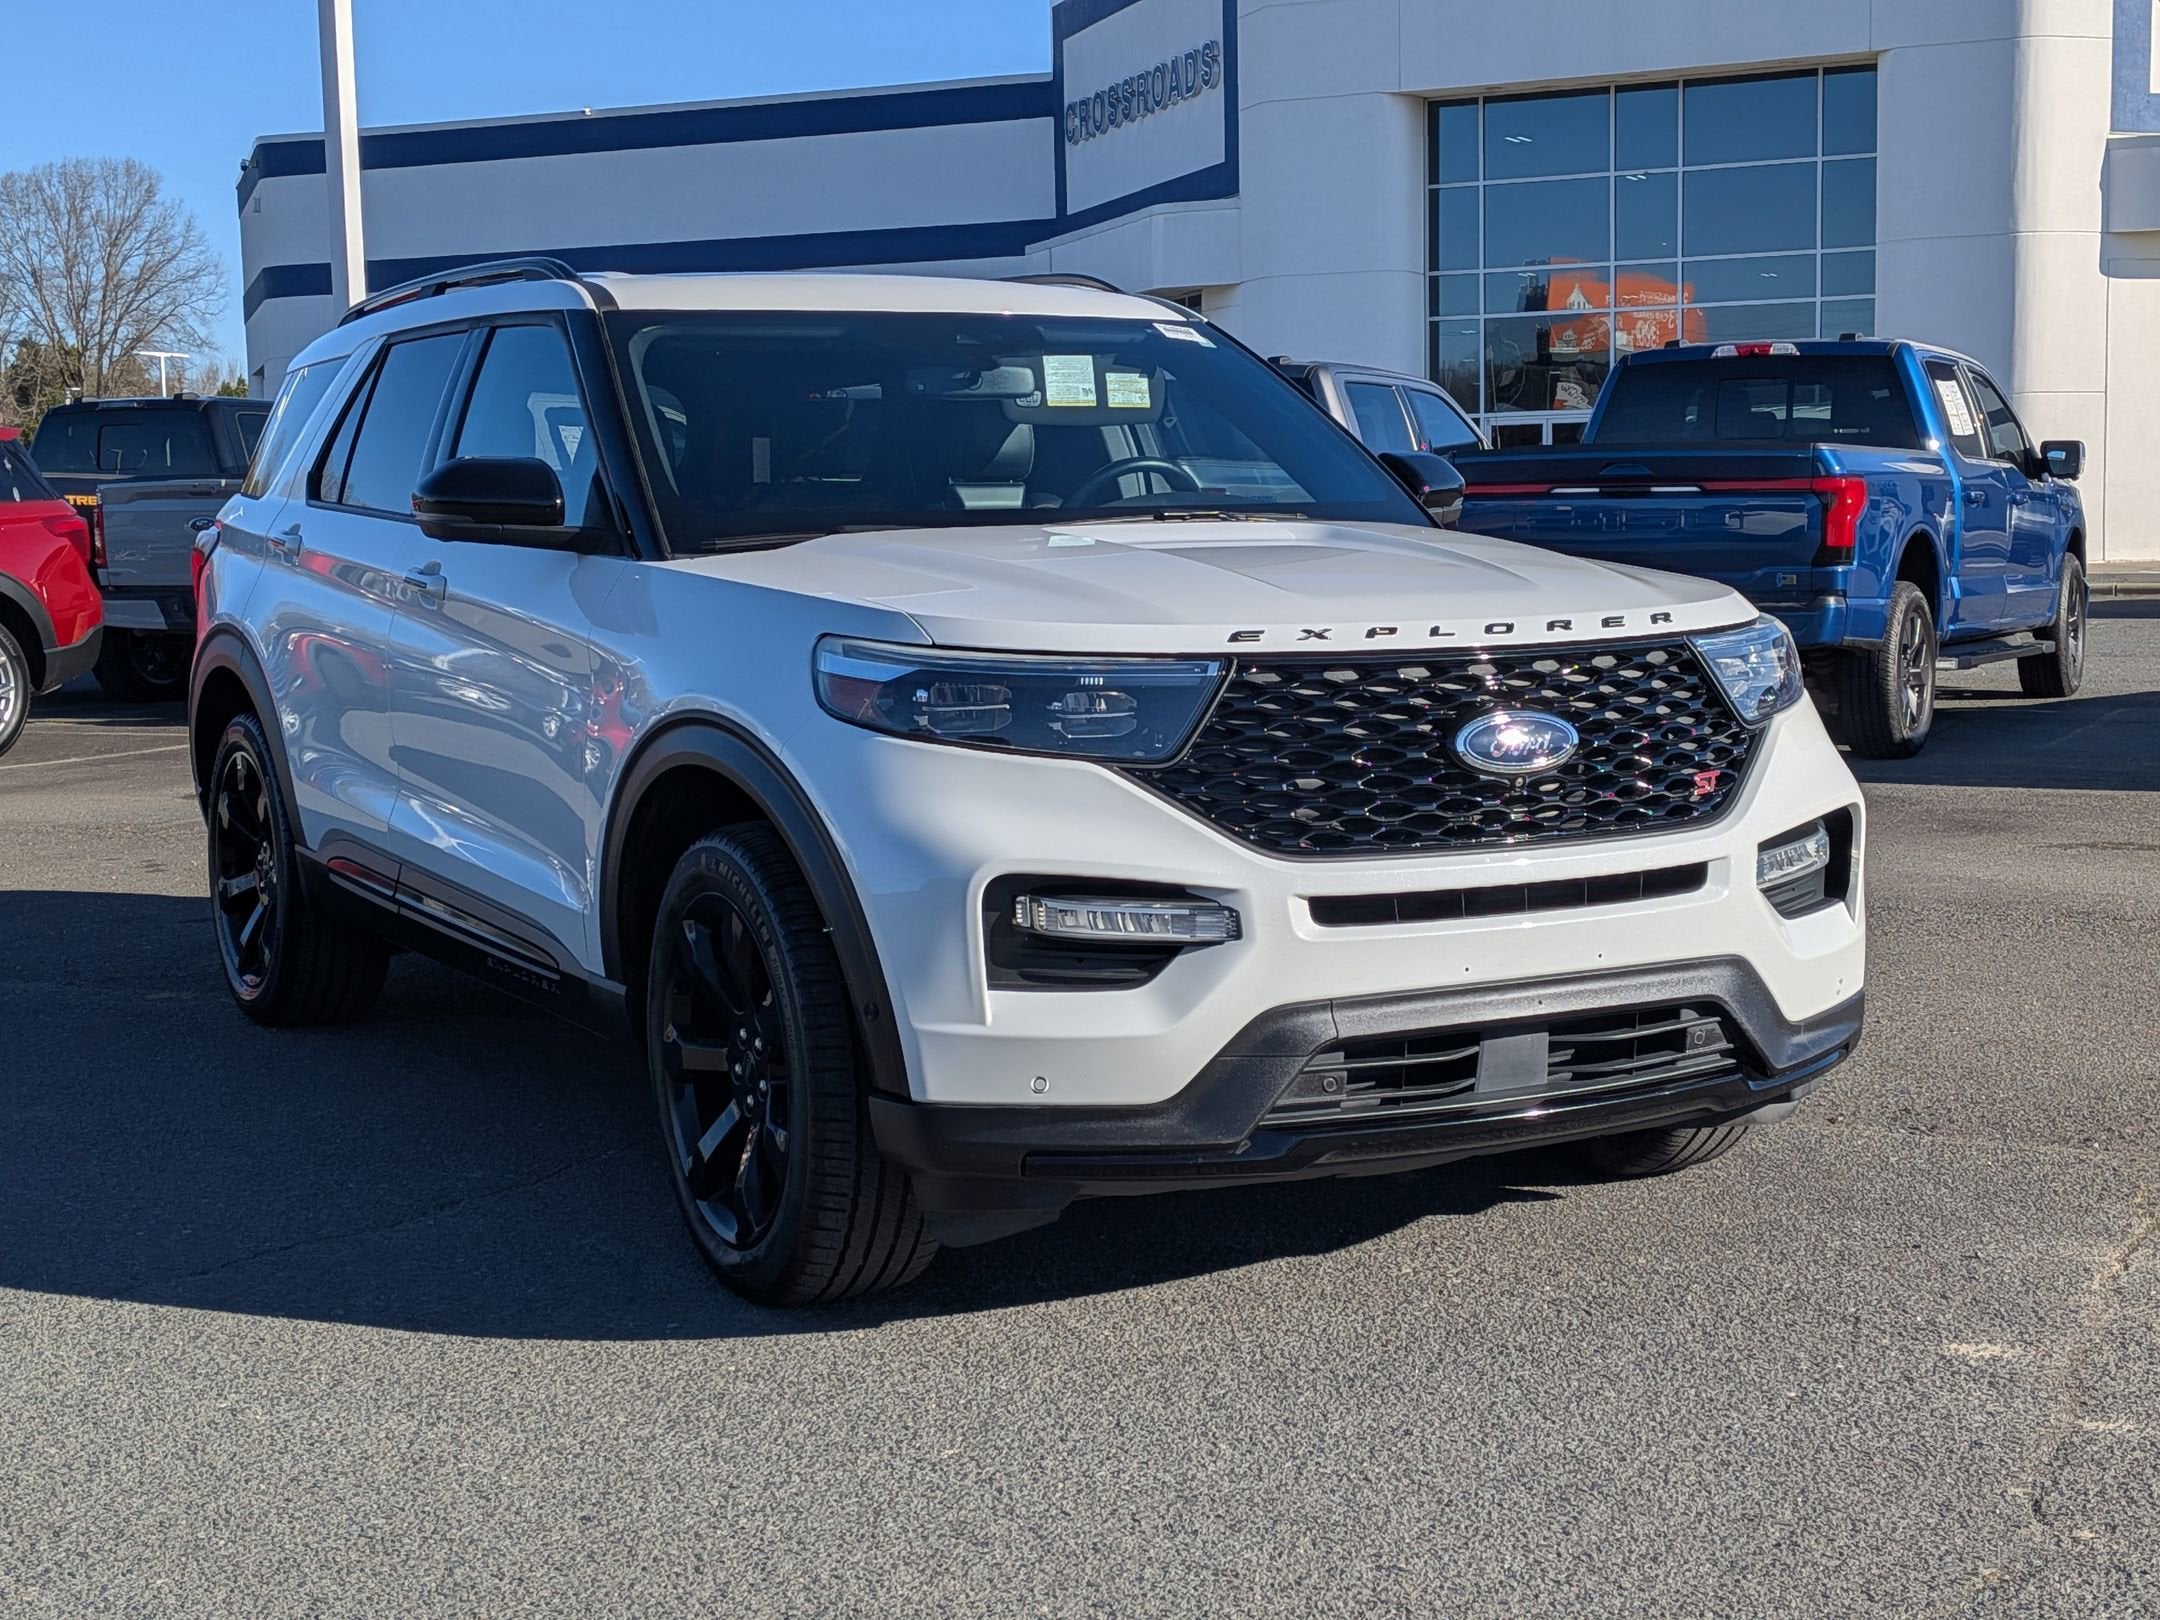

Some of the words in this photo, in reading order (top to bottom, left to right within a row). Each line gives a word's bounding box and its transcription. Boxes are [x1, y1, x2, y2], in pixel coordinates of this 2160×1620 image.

[1065, 40, 1220, 145] CROSSROADS
[1226, 611, 1674, 643] EXPLORER
[1694, 769, 1720, 795] ST
[717, 861, 771, 943] MICHELIN
